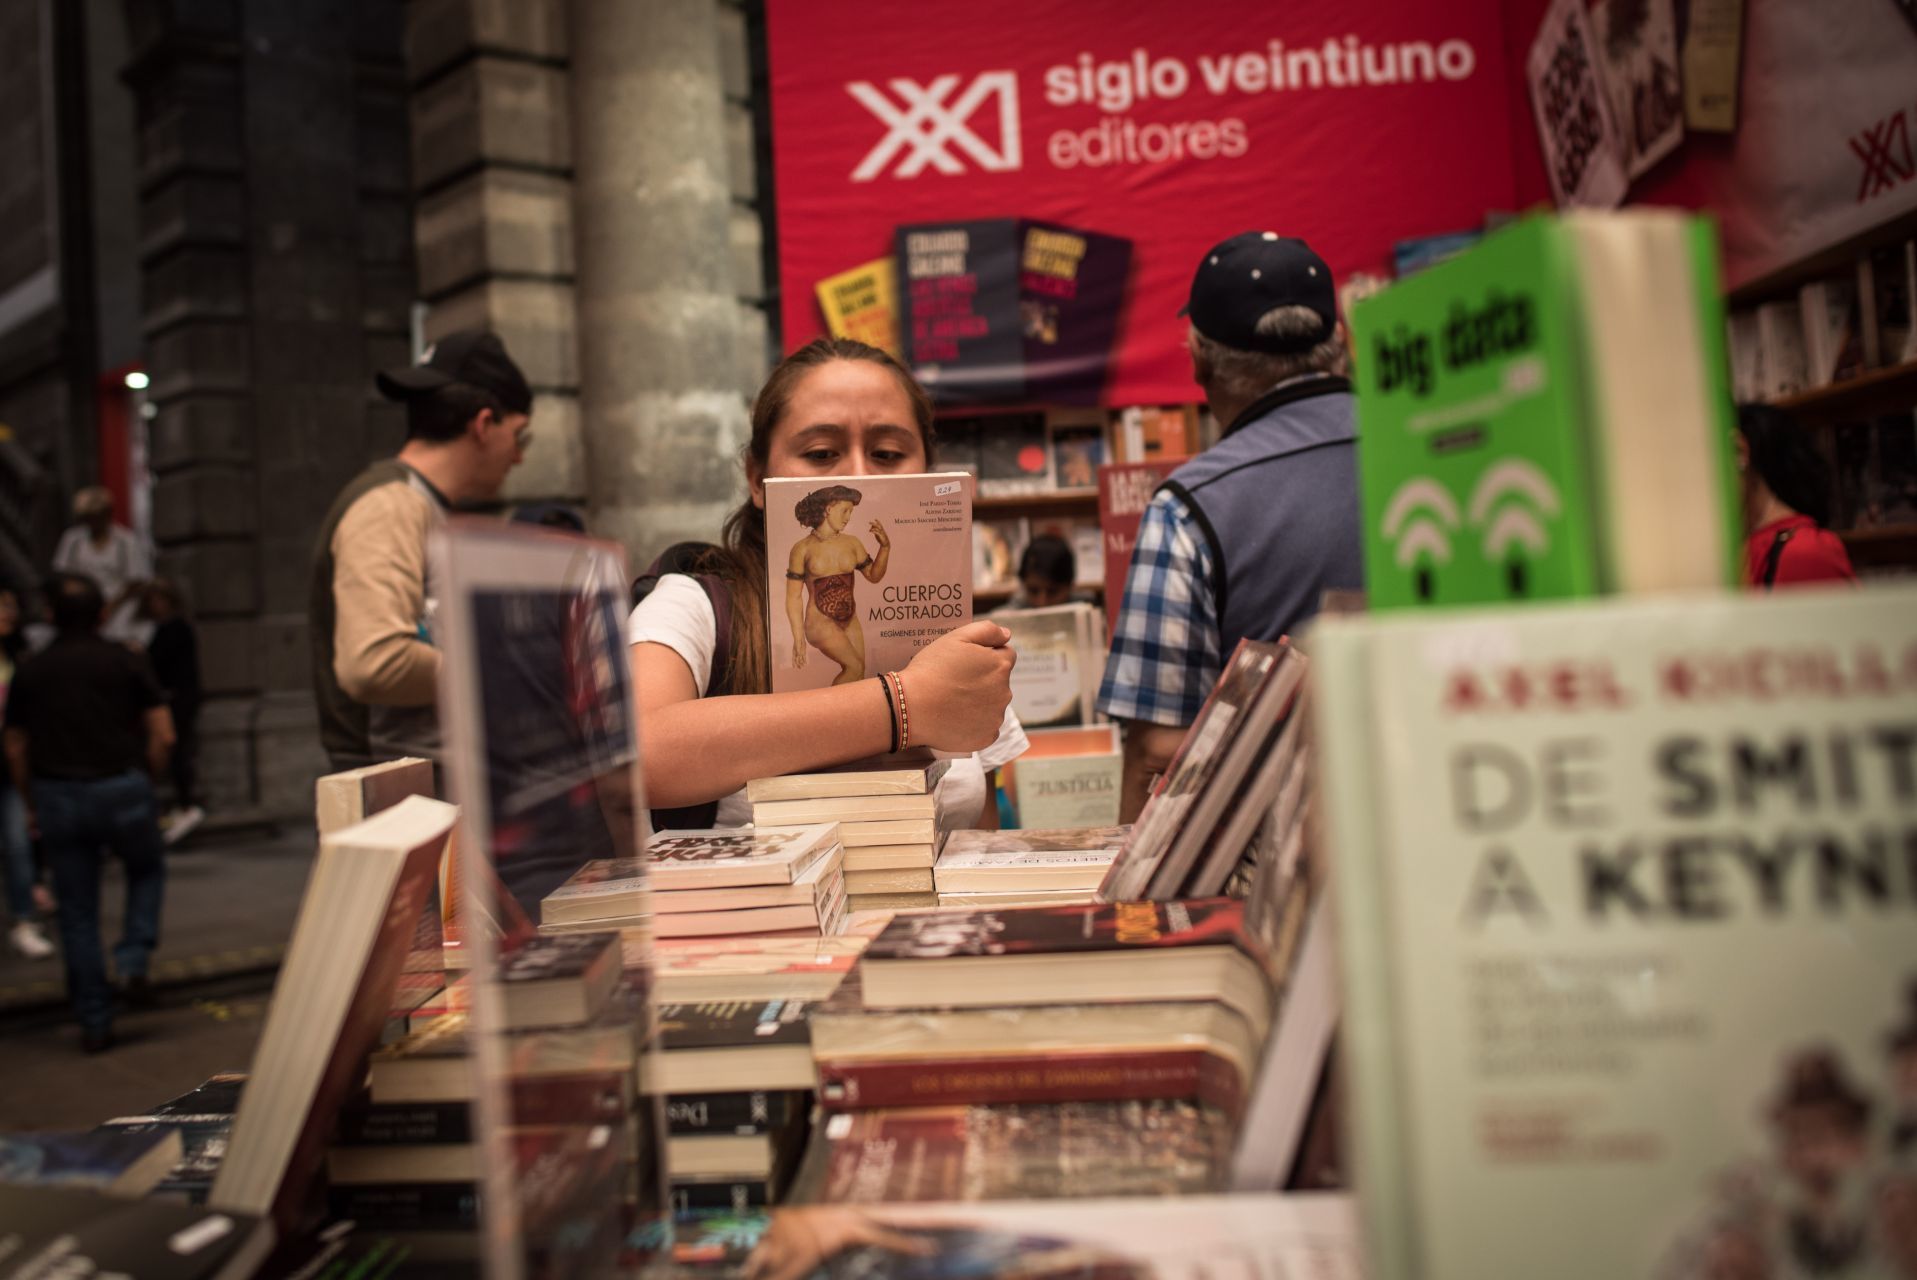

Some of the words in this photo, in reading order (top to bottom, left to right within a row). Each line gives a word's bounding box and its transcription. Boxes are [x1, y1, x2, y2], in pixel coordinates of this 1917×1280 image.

[1044, 50, 1187, 111] siglo
[1200, 36, 1475, 93] veintiuno
[1047, 118, 1248, 168] editores
[1375, 322, 1433, 395] big
[1442, 290, 1538, 371] data
[869, 603, 963, 621] MOSTRADOS
[882, 583, 963, 603] CUERPOS
[880, 629, 916, 637] REGÍMENES
[917, 629, 926, 637] DE
[1038, 774, 1114, 795] JUSTICIA
[1449, 736, 1608, 834] DE
[1460, 846, 1549, 931] A
[1580, 830, 1917, 927] KEYN
